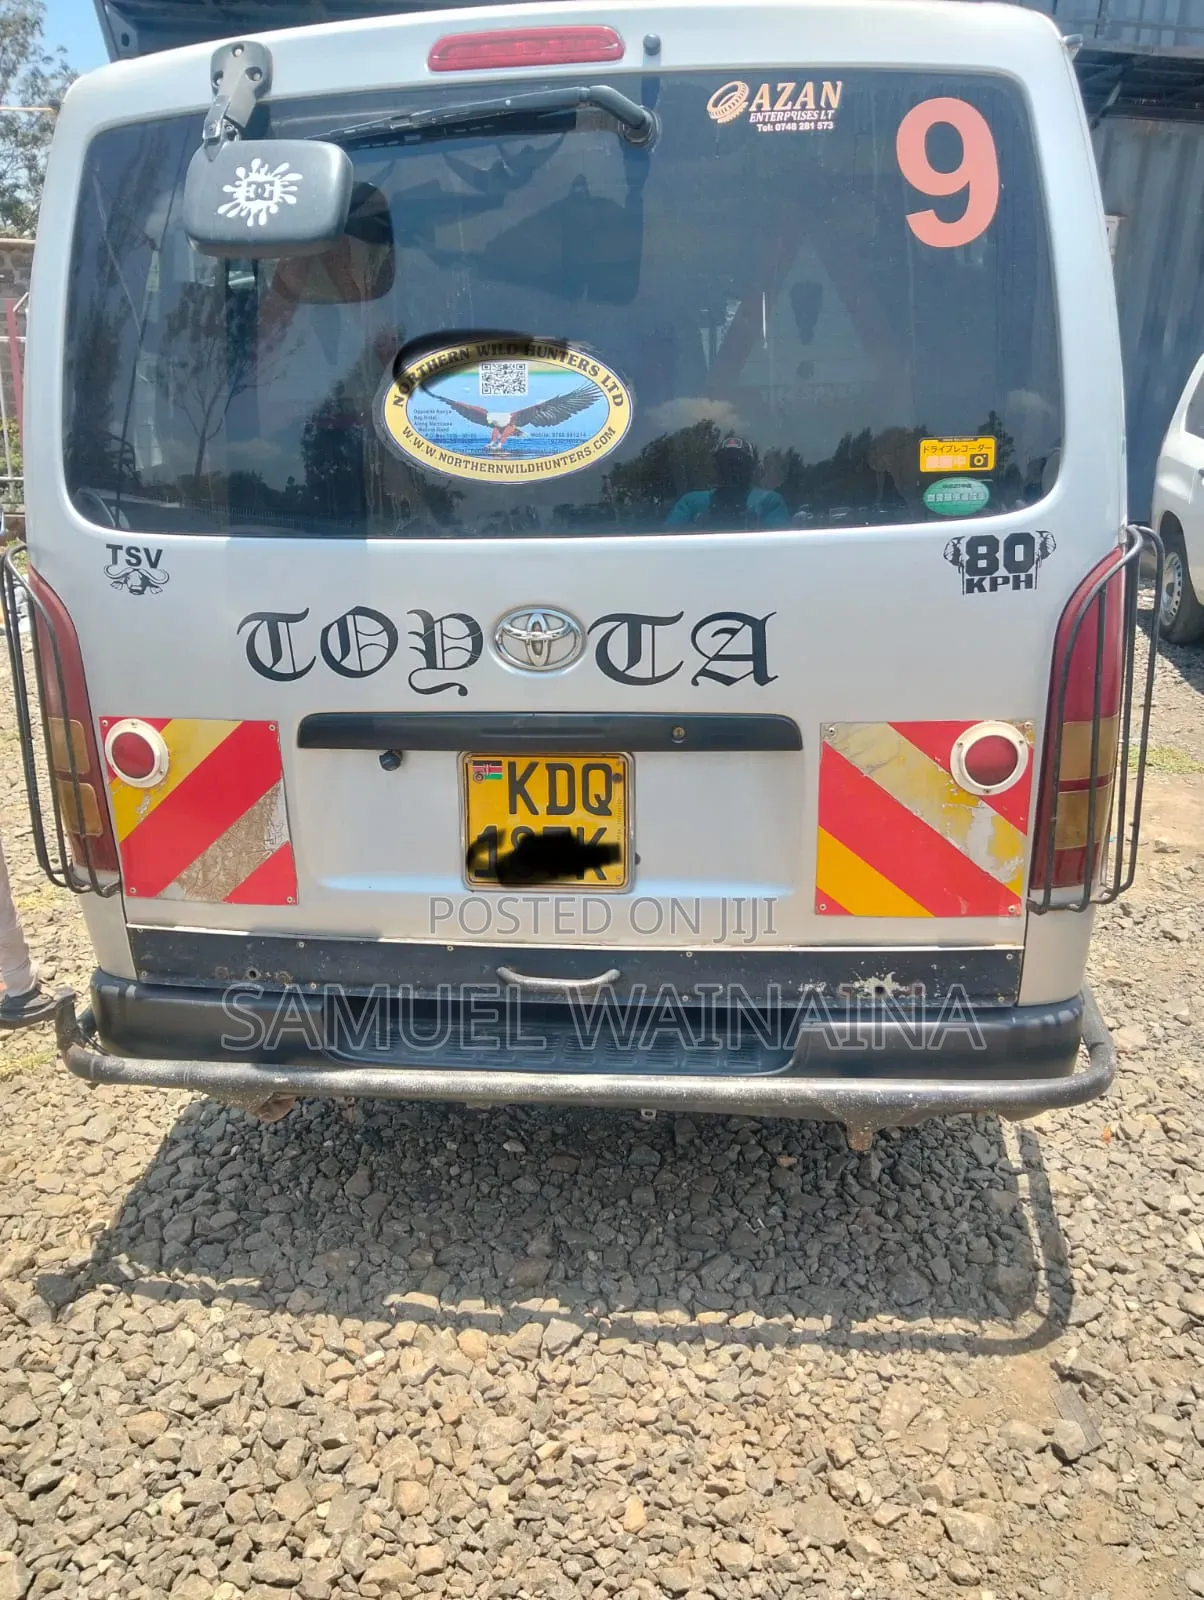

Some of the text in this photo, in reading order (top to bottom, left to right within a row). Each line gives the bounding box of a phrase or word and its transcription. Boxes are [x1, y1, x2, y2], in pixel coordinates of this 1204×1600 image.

[749, 81, 842, 111] AZAN
[896, 97, 999, 248] 9
[392, 343, 624, 408] NORTHERN WILD HUNTERS LTD
[105, 543, 163, 569] TSV
[965, 532, 1036, 577] 80
[965, 573, 1034, 595] KPH
[507, 761, 613, 816] KDQ
